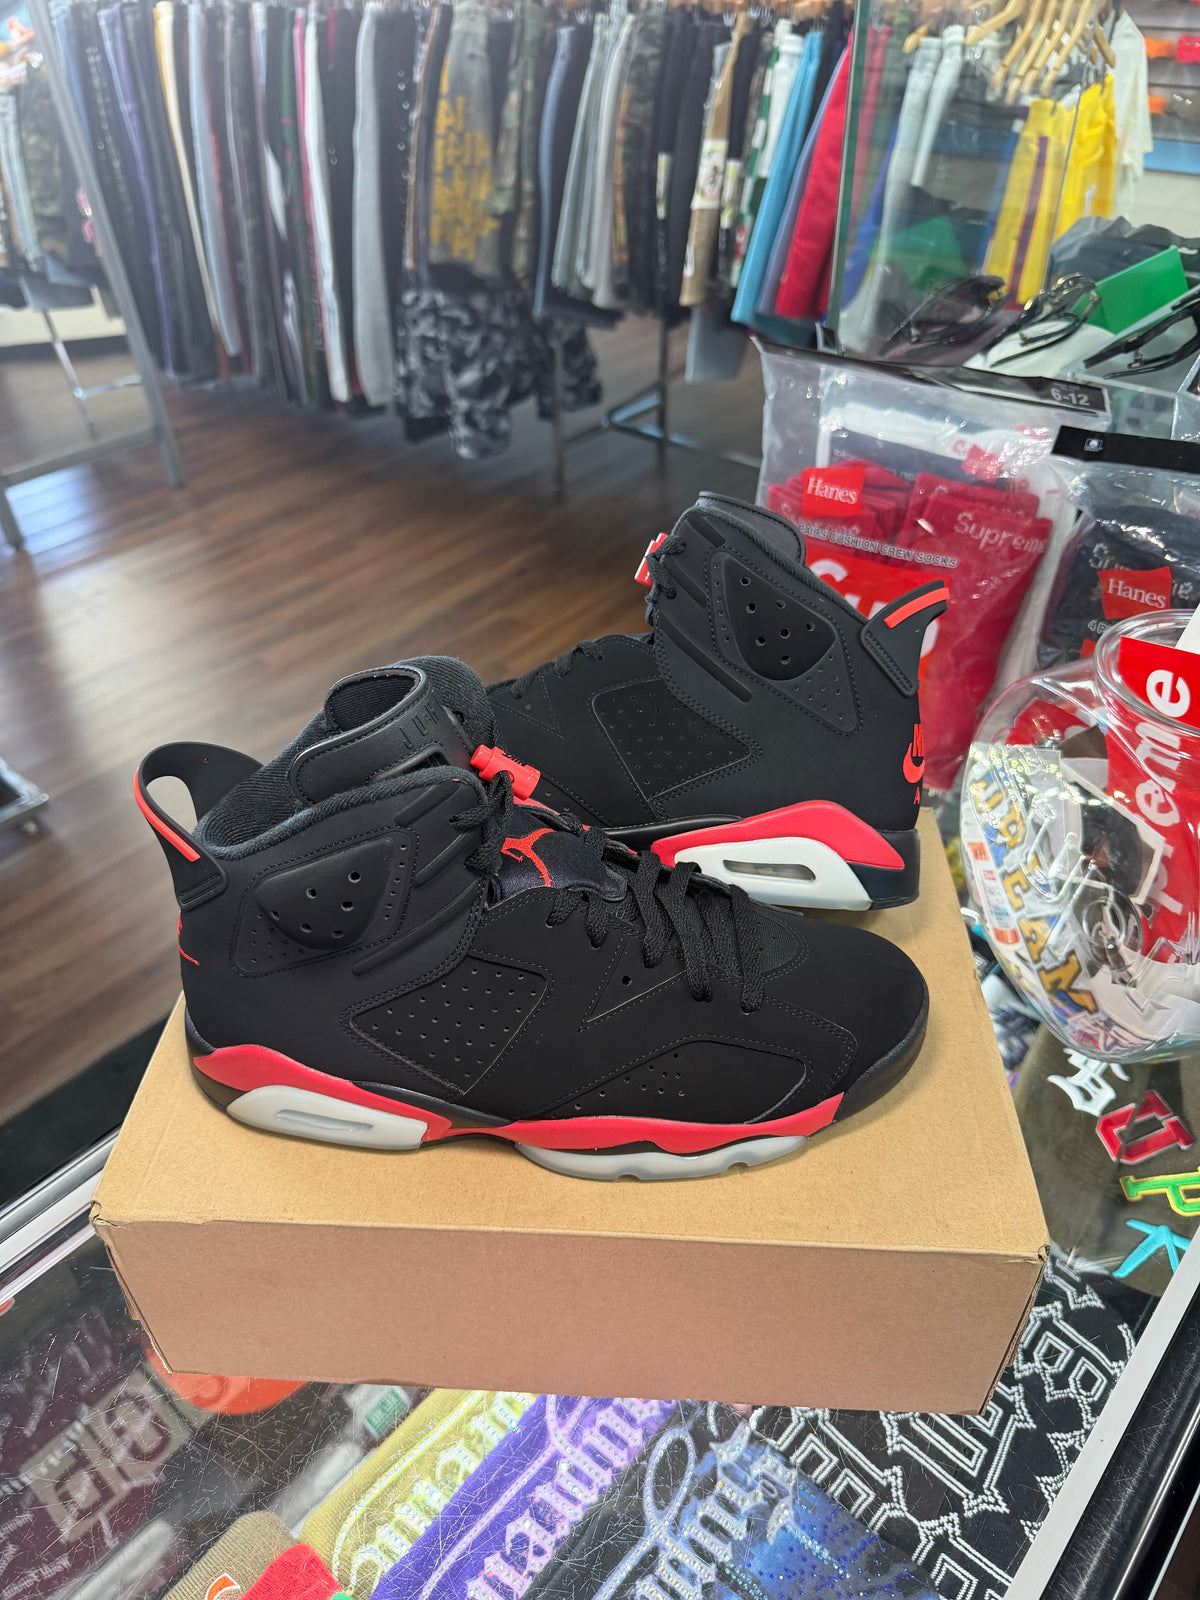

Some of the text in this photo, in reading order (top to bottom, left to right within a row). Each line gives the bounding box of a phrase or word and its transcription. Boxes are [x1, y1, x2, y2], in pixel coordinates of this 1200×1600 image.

[1050, 388, 1090, 406] 6-12
[807, 476, 859, 505] Hanes
[830, 531, 878, 554] CUSHION
[880, 544, 915, 561] CREW
[915, 552, 958, 569] SOCKS
[1108, 578, 1166, 609] Hanes
